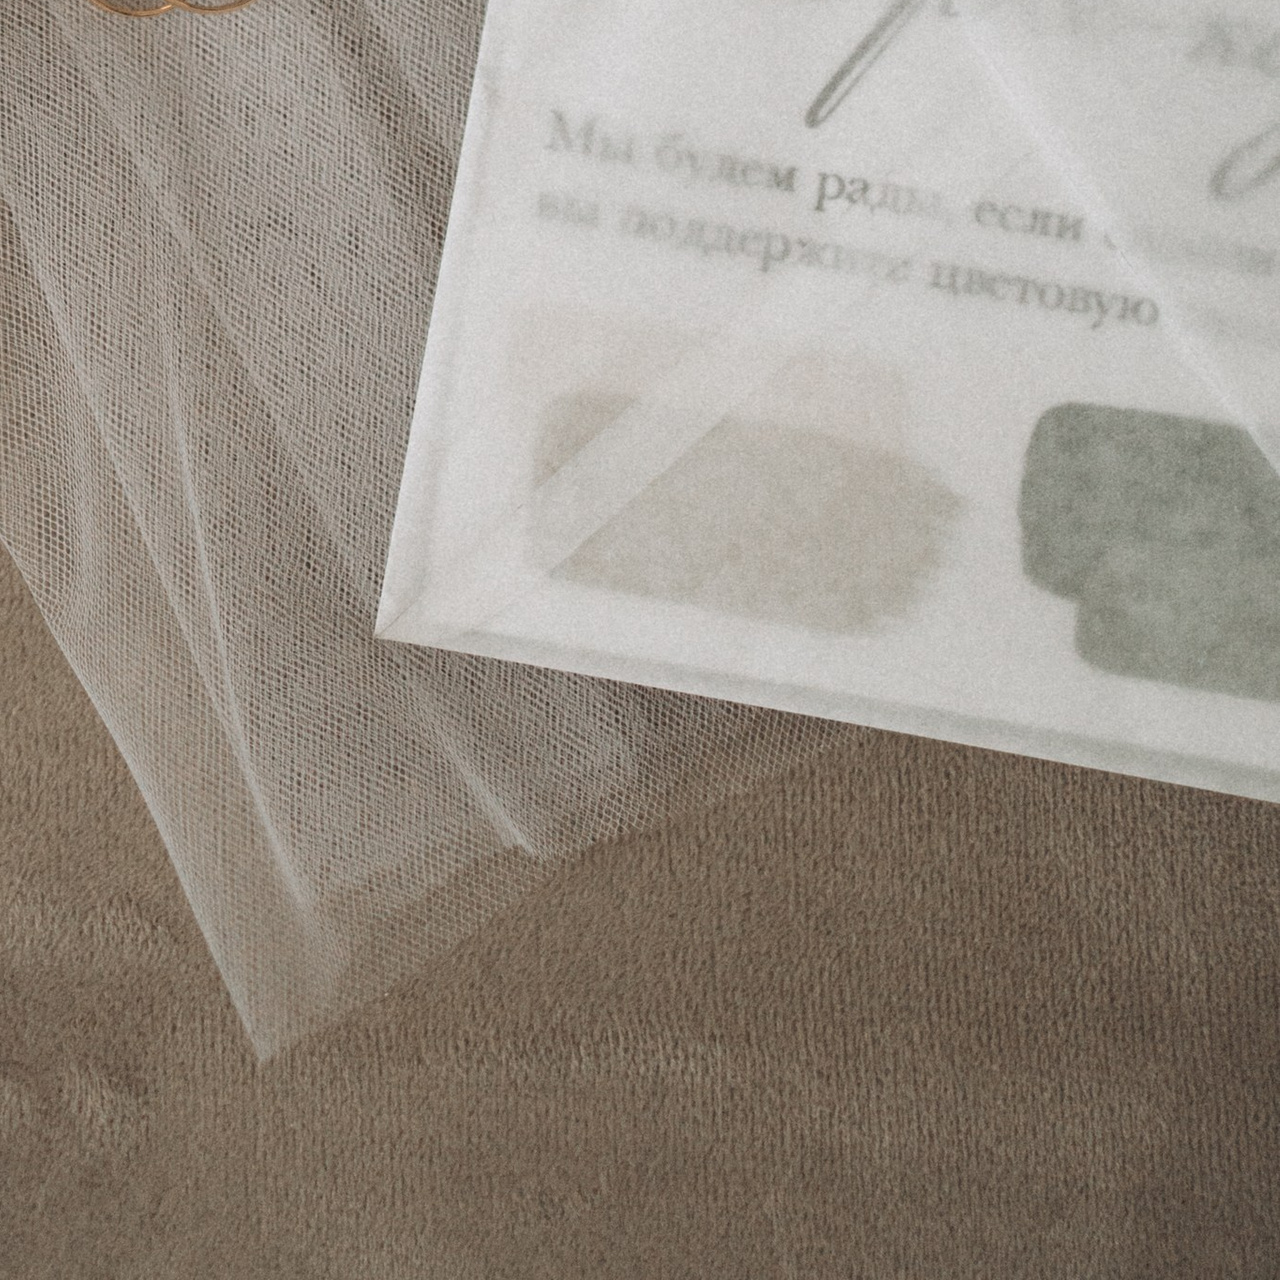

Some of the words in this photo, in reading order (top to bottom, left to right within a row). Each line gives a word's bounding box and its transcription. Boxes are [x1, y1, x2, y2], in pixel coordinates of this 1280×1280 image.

[543, 108, 636, 165] Мы
[653, 132, 801, 195] будем
[972, 198, 1086, 244] если
[535, 190, 601, 230] вы
[618, 202, 914, 283] поддержите
[927, 259, 1162, 332] цветовую
